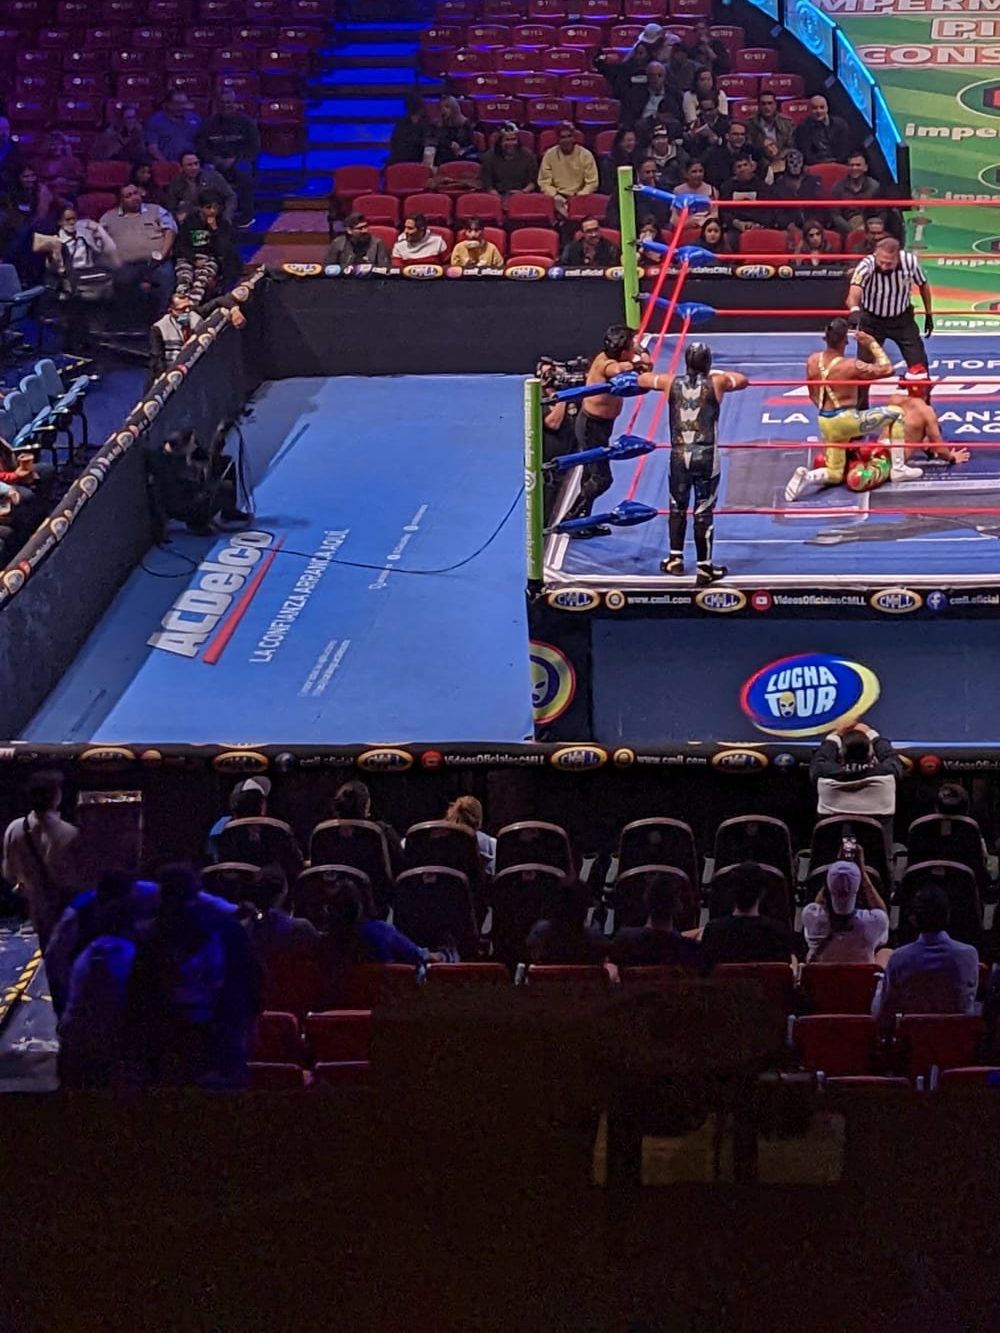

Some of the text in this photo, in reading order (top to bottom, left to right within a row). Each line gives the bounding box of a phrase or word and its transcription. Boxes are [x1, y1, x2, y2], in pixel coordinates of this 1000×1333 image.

[761, 412, 810, 423] LA
[146, 531, 275, 659] ACDelco
[704, 593, 738, 607] CMLL
[879, 593, 914, 608] CMLL
[767, 665, 838, 693] LUCHA
[637, 754, 707, 765] wwwcmllcom
